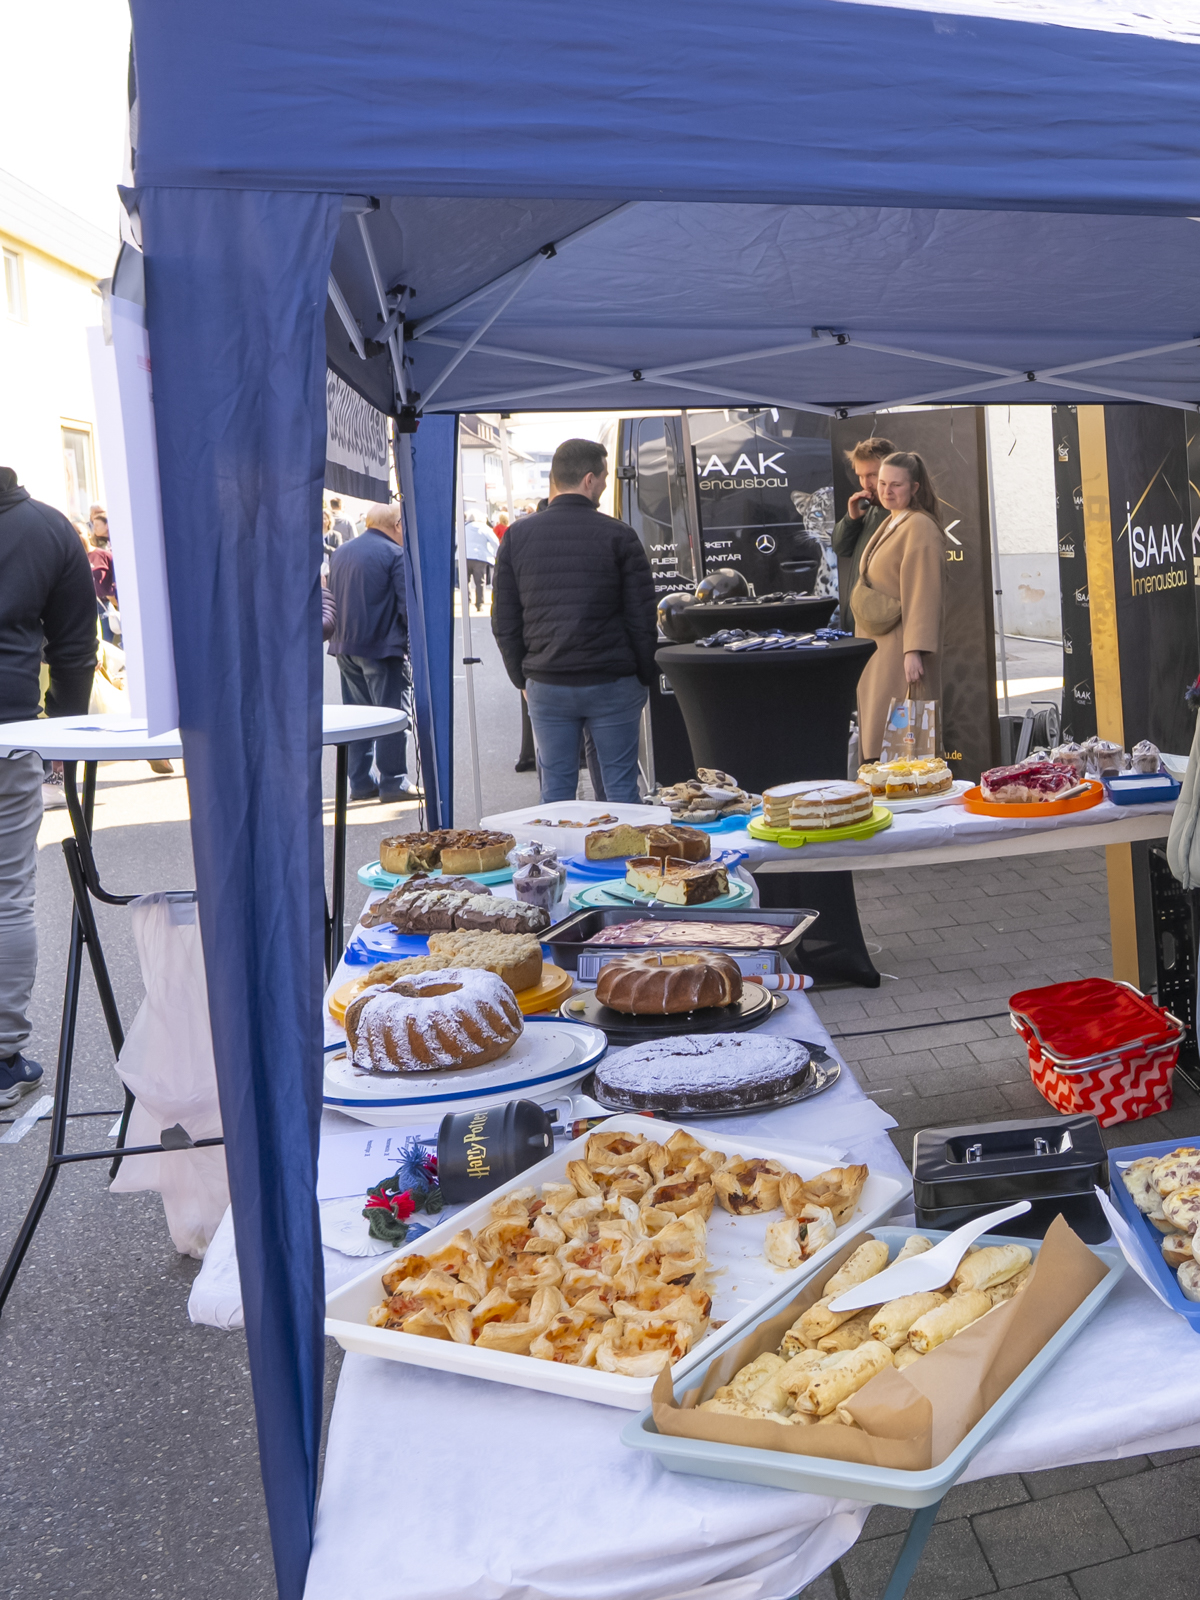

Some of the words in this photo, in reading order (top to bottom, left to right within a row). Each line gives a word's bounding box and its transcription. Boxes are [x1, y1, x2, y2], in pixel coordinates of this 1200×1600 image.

[706, 554, 742, 562] ANITÄR
[464, 1111, 490, 1143] Potter
[467, 1143, 491, 1179] Harry
